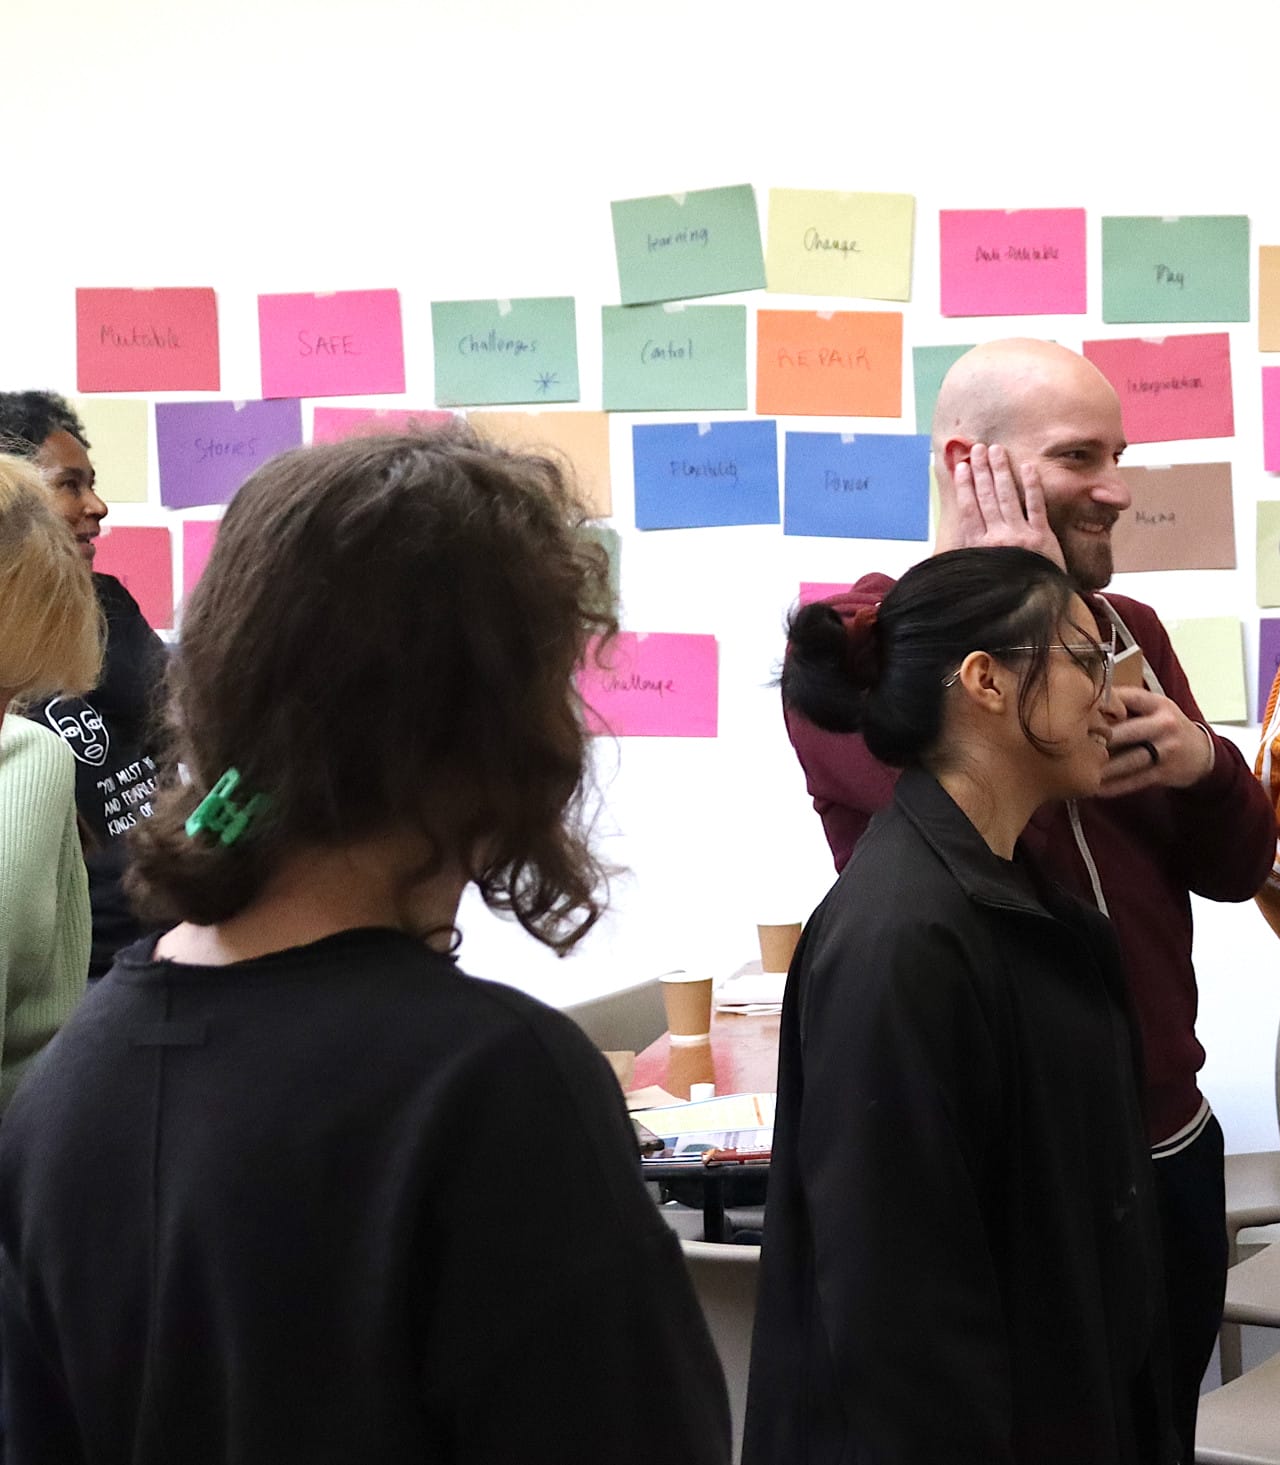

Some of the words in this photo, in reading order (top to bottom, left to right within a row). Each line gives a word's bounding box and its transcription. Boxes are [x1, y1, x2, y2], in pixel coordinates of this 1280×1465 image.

[298, 330, 361, 356] SAFE
[640, 338, 692, 364] Control
[777, 347, 871, 370] REPAIR
[115, 762, 142, 786] MUST
[104, 798, 122, 818] AND
[121, 777, 159, 806] FEARLE
[107, 812, 137, 837] KINDS
